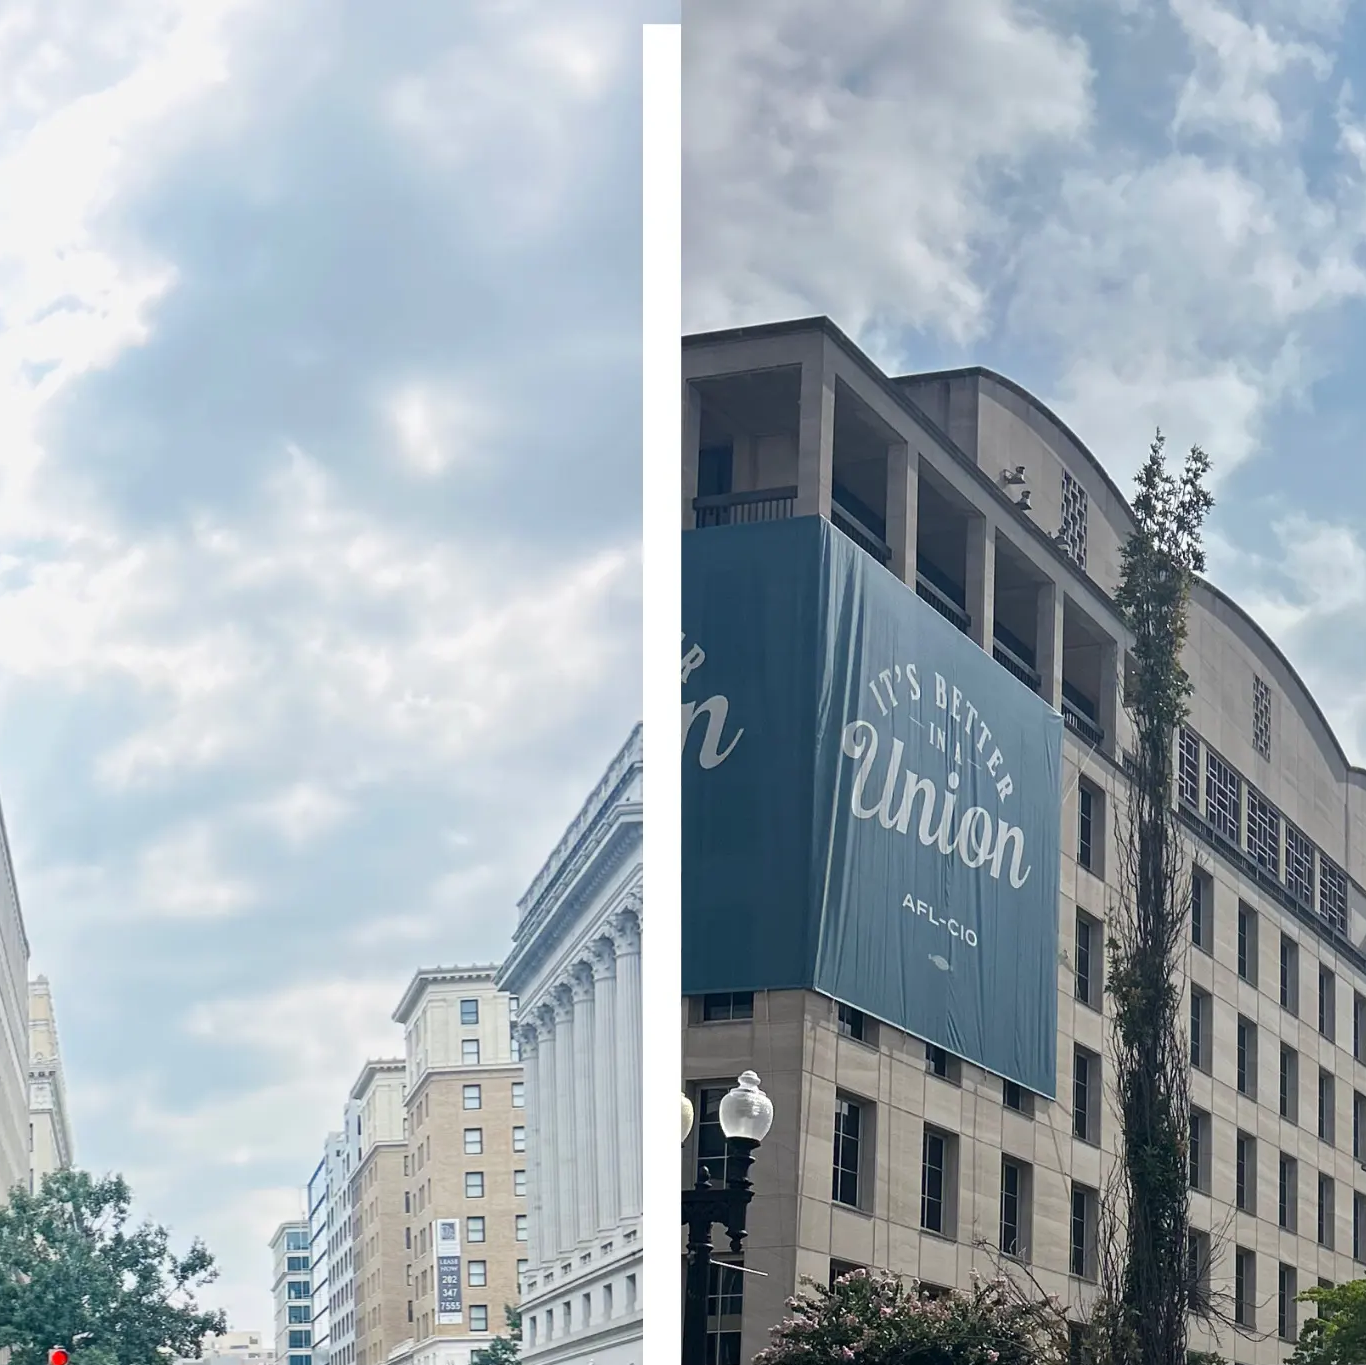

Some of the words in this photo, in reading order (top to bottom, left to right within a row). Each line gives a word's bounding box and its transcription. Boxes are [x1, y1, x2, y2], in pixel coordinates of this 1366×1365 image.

[869, 663, 921, 717] IT'S
[934, 671, 1014, 804] BETTER
[929, 721, 946, 753] IN
[954, 731, 963, 765] A
[842, 719, 1032, 889] Union
[902, 893, 978, 947] AFL-CIO
[442, 1275, 458, 1284] 202
[442, 1288, 458, 1297] 347
[441, 1301, 461, 1310] 7555
